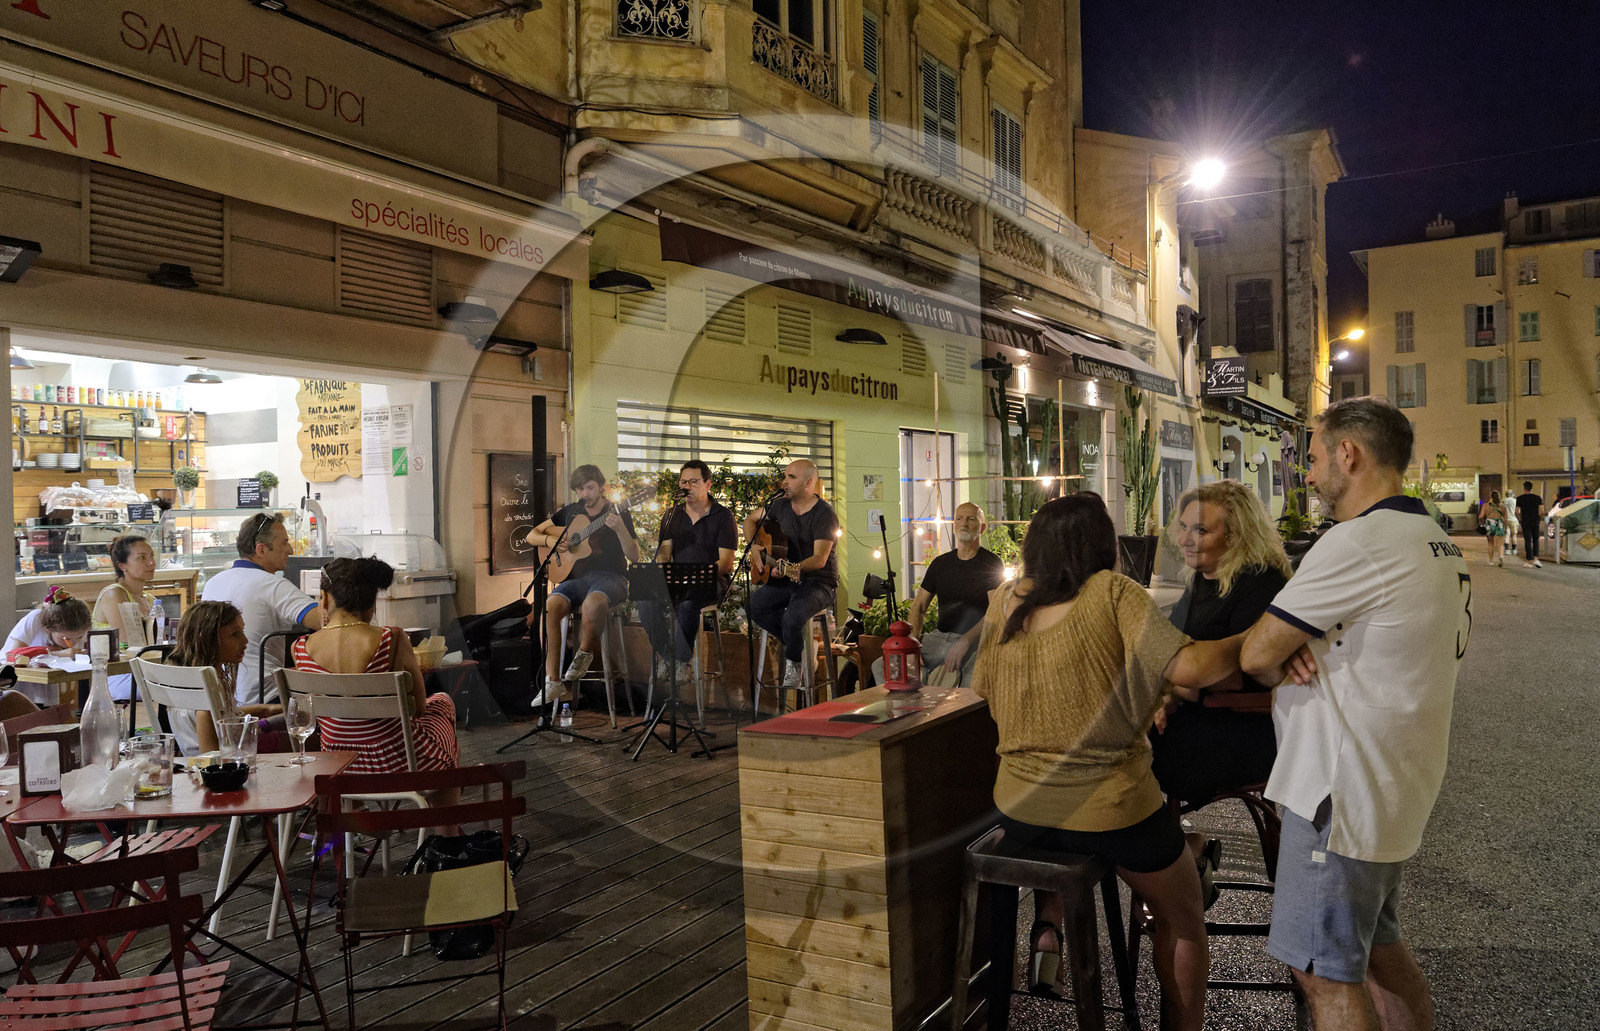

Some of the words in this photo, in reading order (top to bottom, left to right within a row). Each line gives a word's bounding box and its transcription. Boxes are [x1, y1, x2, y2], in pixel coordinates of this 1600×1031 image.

[120, 10, 293, 101] SAVEURS
[305, 75, 366, 127] D'ICI
[351, 198, 470, 247] spécialités
[480, 226, 544, 265] locales
[848, 276, 954, 325] Aupaysducitron
[1207, 362, 1245, 374] MARTIN
[760, 354, 898, 400] Aupaysducitron
[1207, 373, 1224, 387] &
[1221, 373, 1245, 384] FILS
[309, 380, 347, 395] FABRIQUE
[308, 406, 321, 415] FAIT
[330, 406, 337, 414] LA
[339, 404, 355, 412] MAIN
[310, 424, 339, 439] FARINE
[311, 443, 349, 459] PRODUITS
